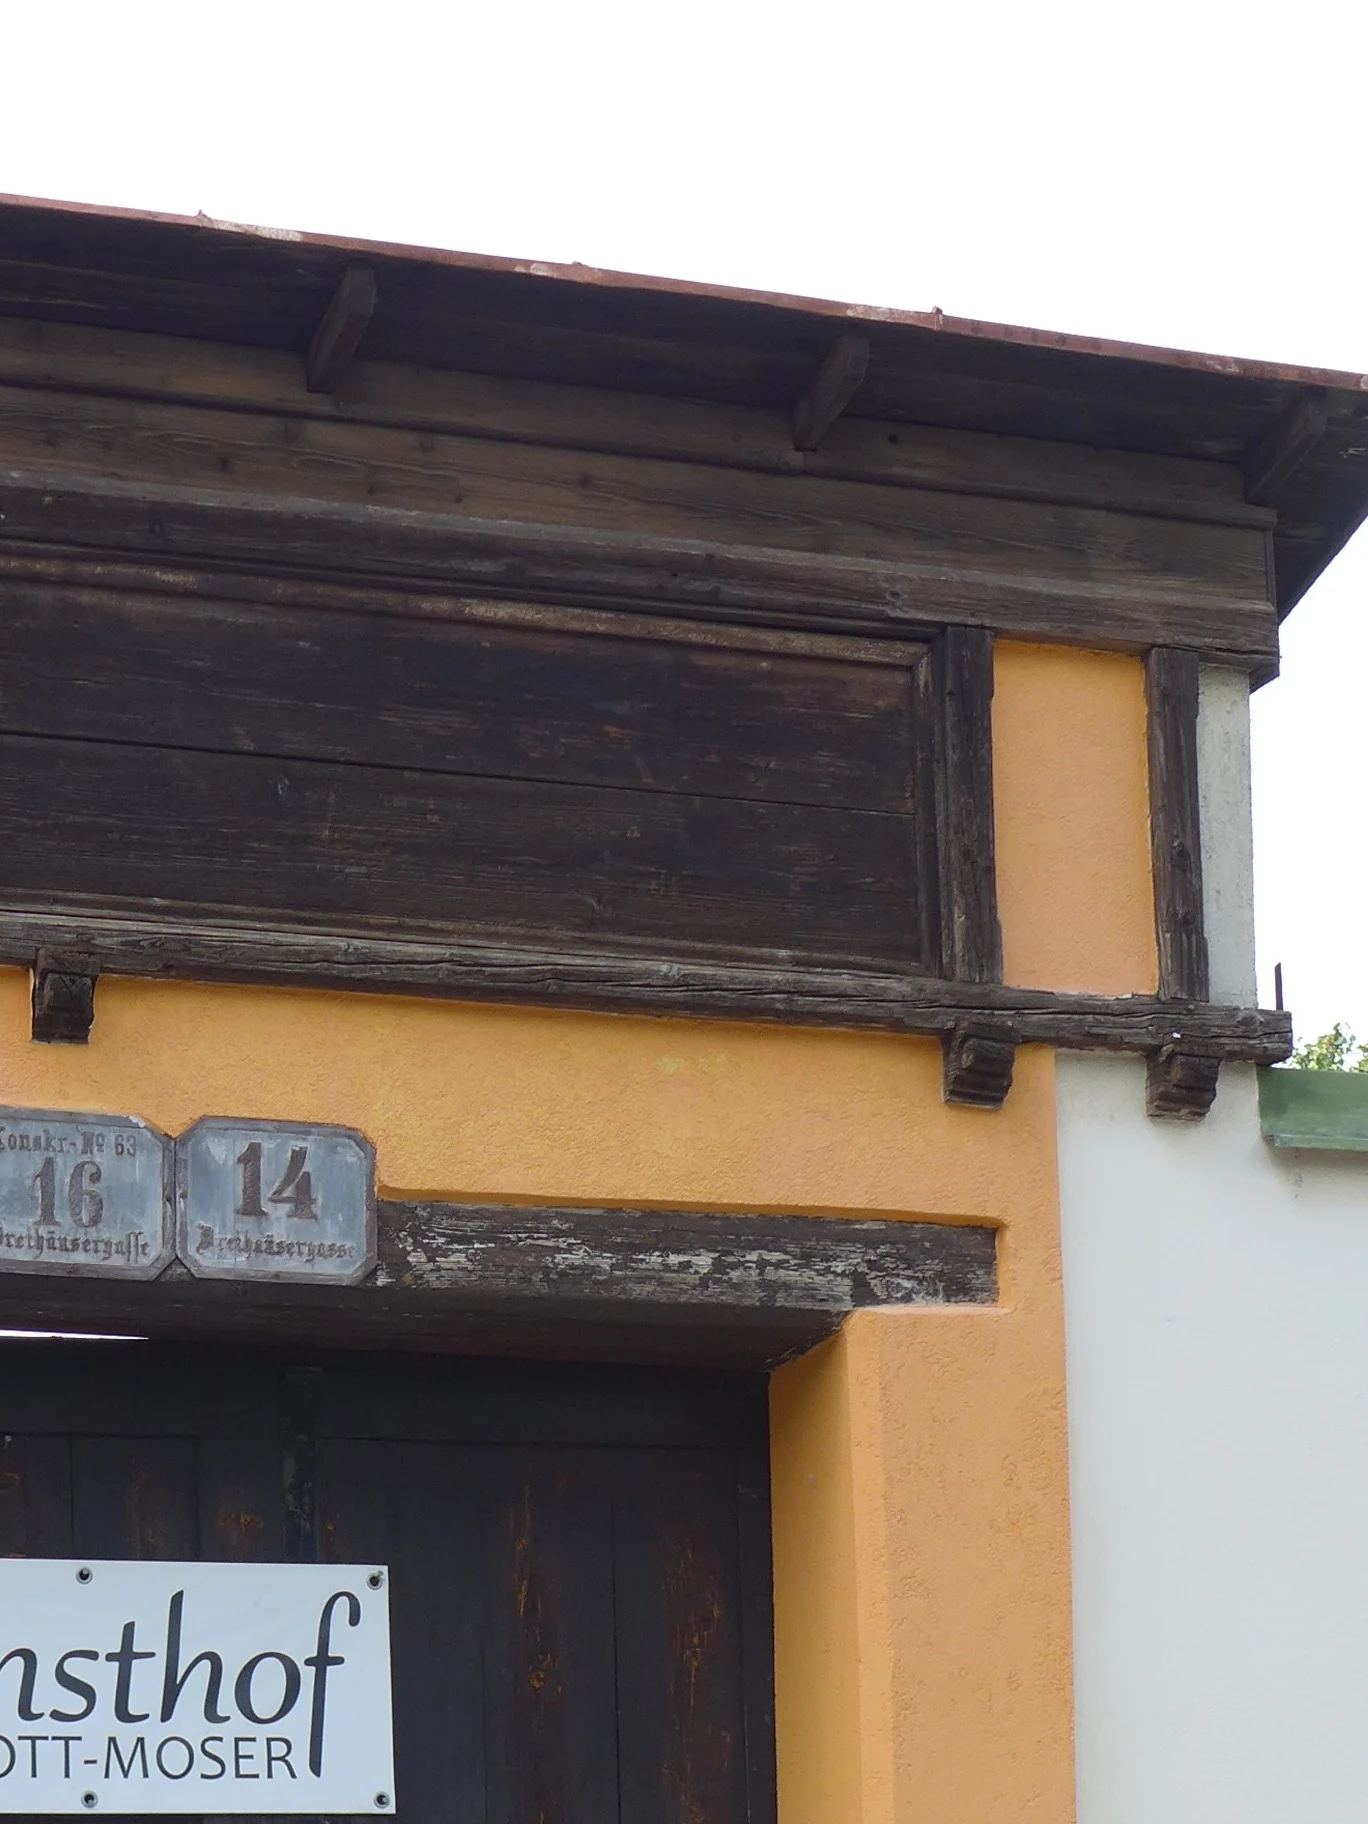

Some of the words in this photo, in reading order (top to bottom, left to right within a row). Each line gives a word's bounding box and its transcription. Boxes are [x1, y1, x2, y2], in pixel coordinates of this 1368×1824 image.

[114, 1134, 136, 1157] 63
[236, 1141, 318, 1220] 14
[32, 1156, 104, 1228] 16
